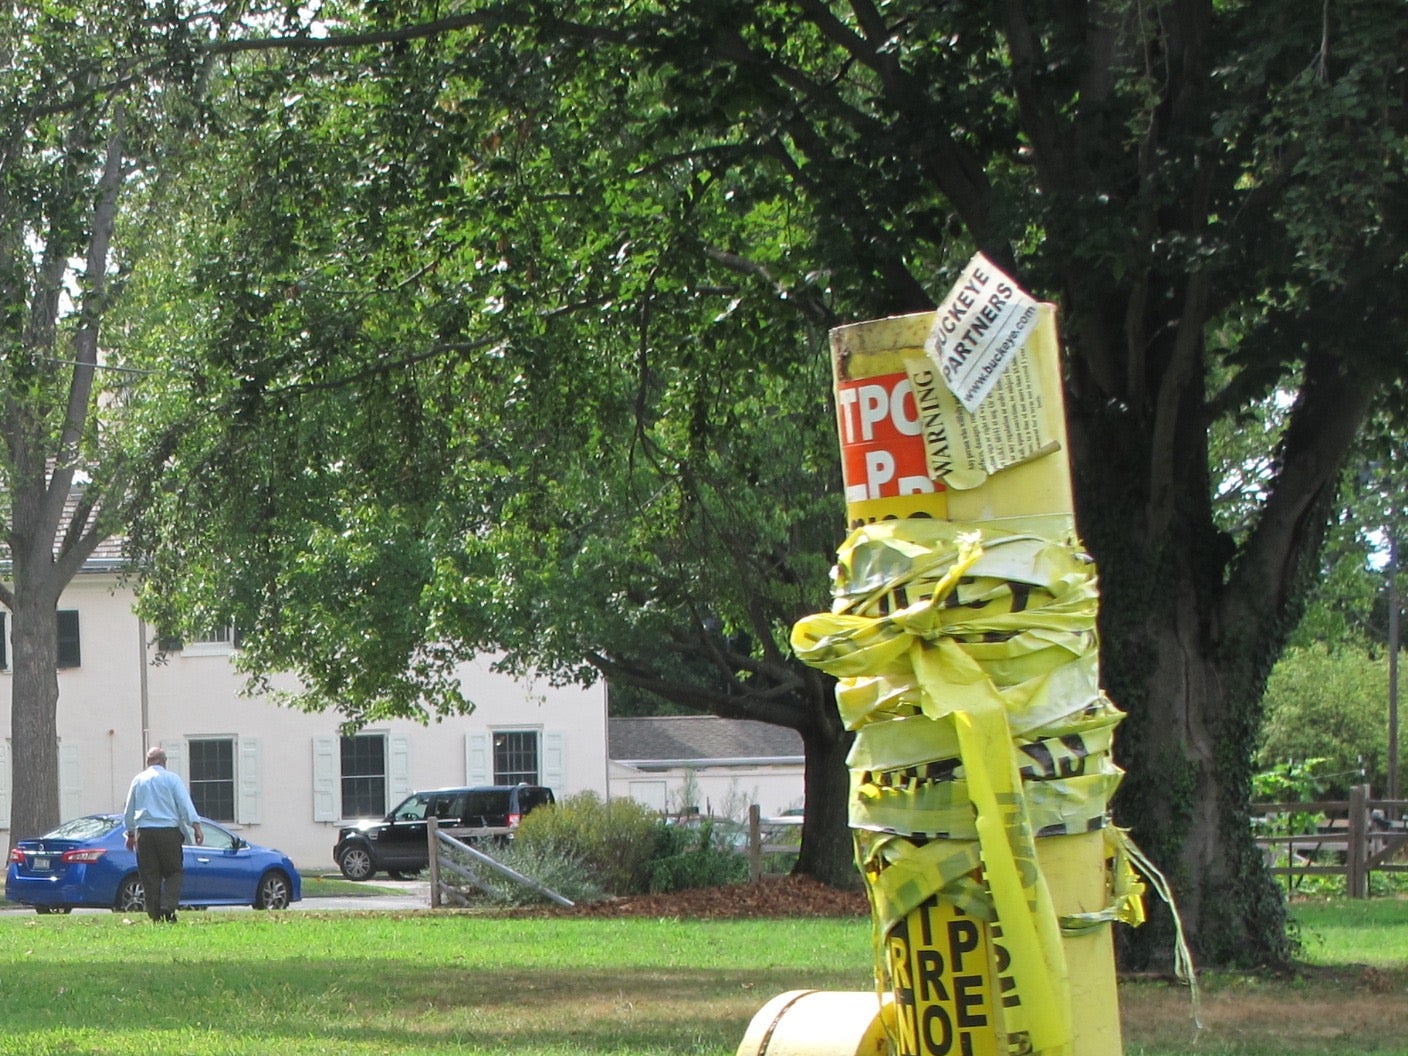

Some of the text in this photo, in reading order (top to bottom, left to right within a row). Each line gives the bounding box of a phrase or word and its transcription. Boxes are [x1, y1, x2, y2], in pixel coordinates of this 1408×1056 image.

[934, 268, 989, 356] BUCKEYE
[943, 283, 1013, 383] PARTNERS
[964, 306, 1035, 402] www.buckeye.com
[913, 370, 954, 478] WARNING
